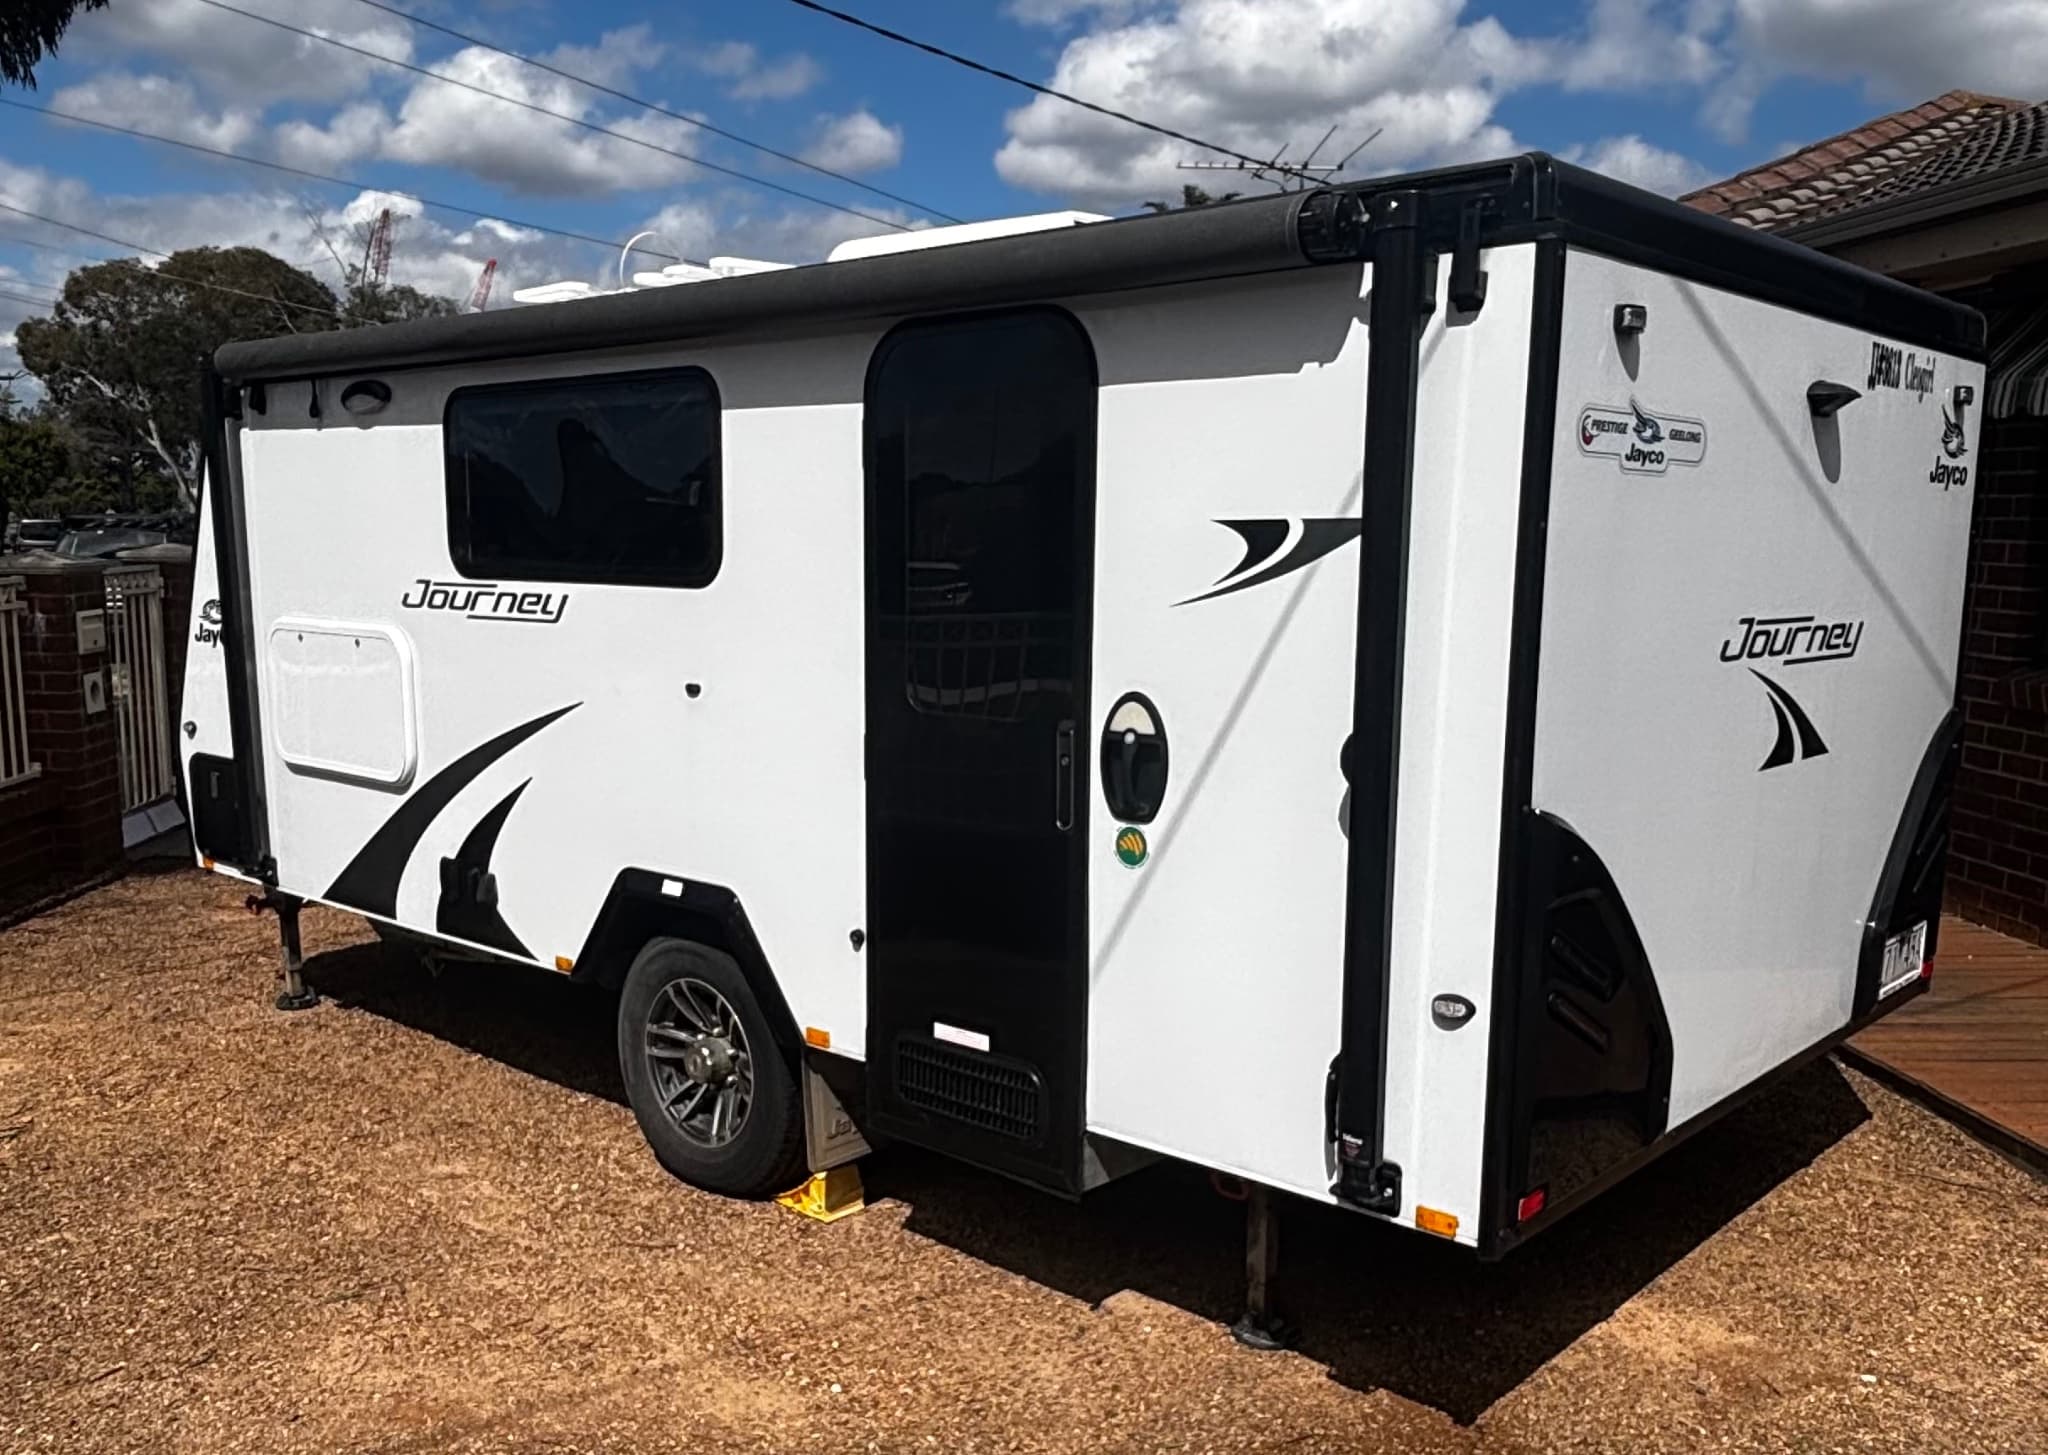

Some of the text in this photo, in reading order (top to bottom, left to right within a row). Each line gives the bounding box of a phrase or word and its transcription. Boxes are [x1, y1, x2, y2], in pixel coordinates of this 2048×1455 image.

[1591, 418, 1702, 443] PRESTIGE GEELONG
[1625, 443, 1665, 467] Jayco
[1930, 455, 1968, 491] Jayco
[402, 579, 569, 623] Journey
[1720, 616, 1864, 665] Journey
